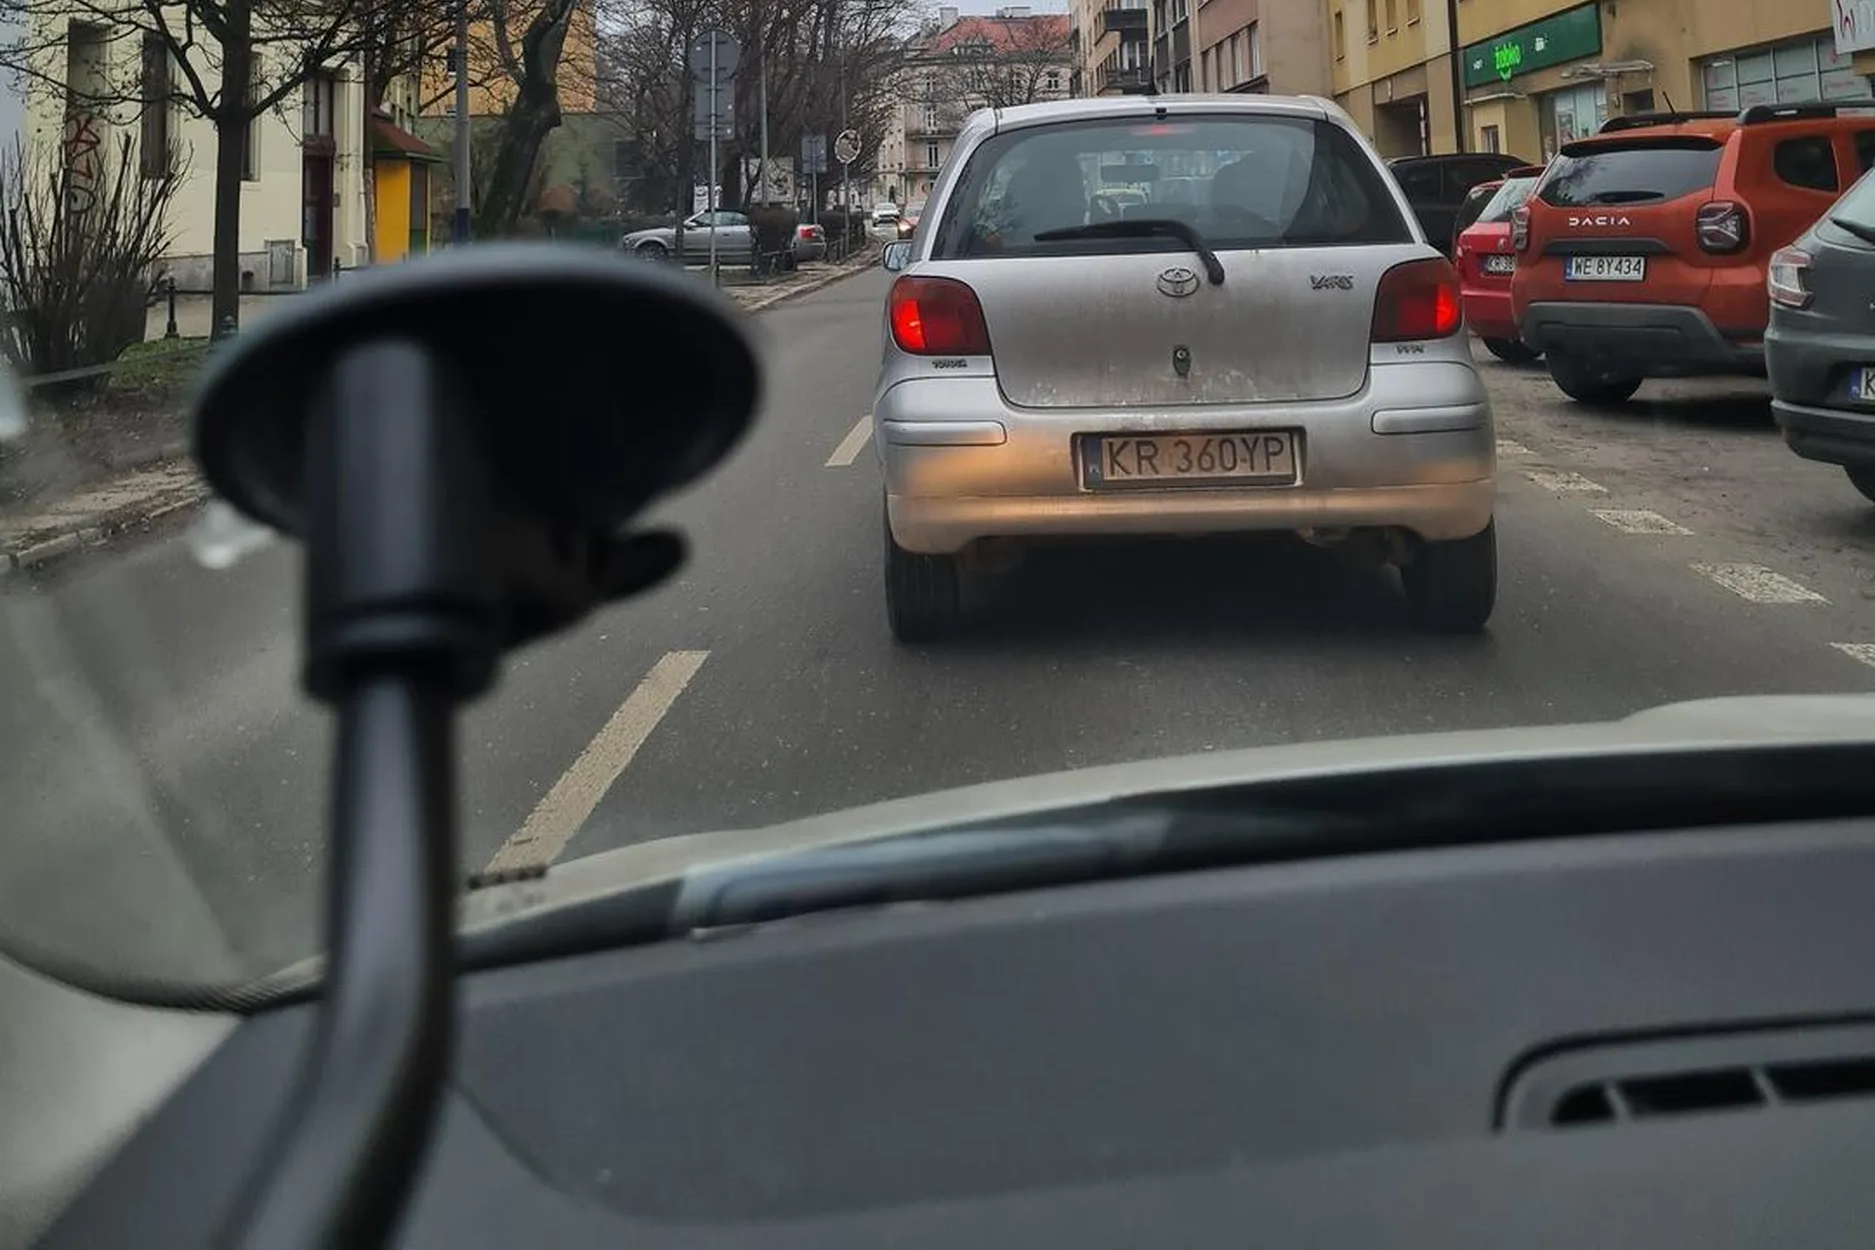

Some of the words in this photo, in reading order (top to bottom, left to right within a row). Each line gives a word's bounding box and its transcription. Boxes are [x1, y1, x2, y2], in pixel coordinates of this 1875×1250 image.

[1568, 216, 1631, 227] DACIA
[1575, 257, 1593, 276] WE
[1596, 257, 1642, 276] 8Y434
[1106, 440, 1161, 476] KR
[1173, 436, 1285, 474] 360YP
